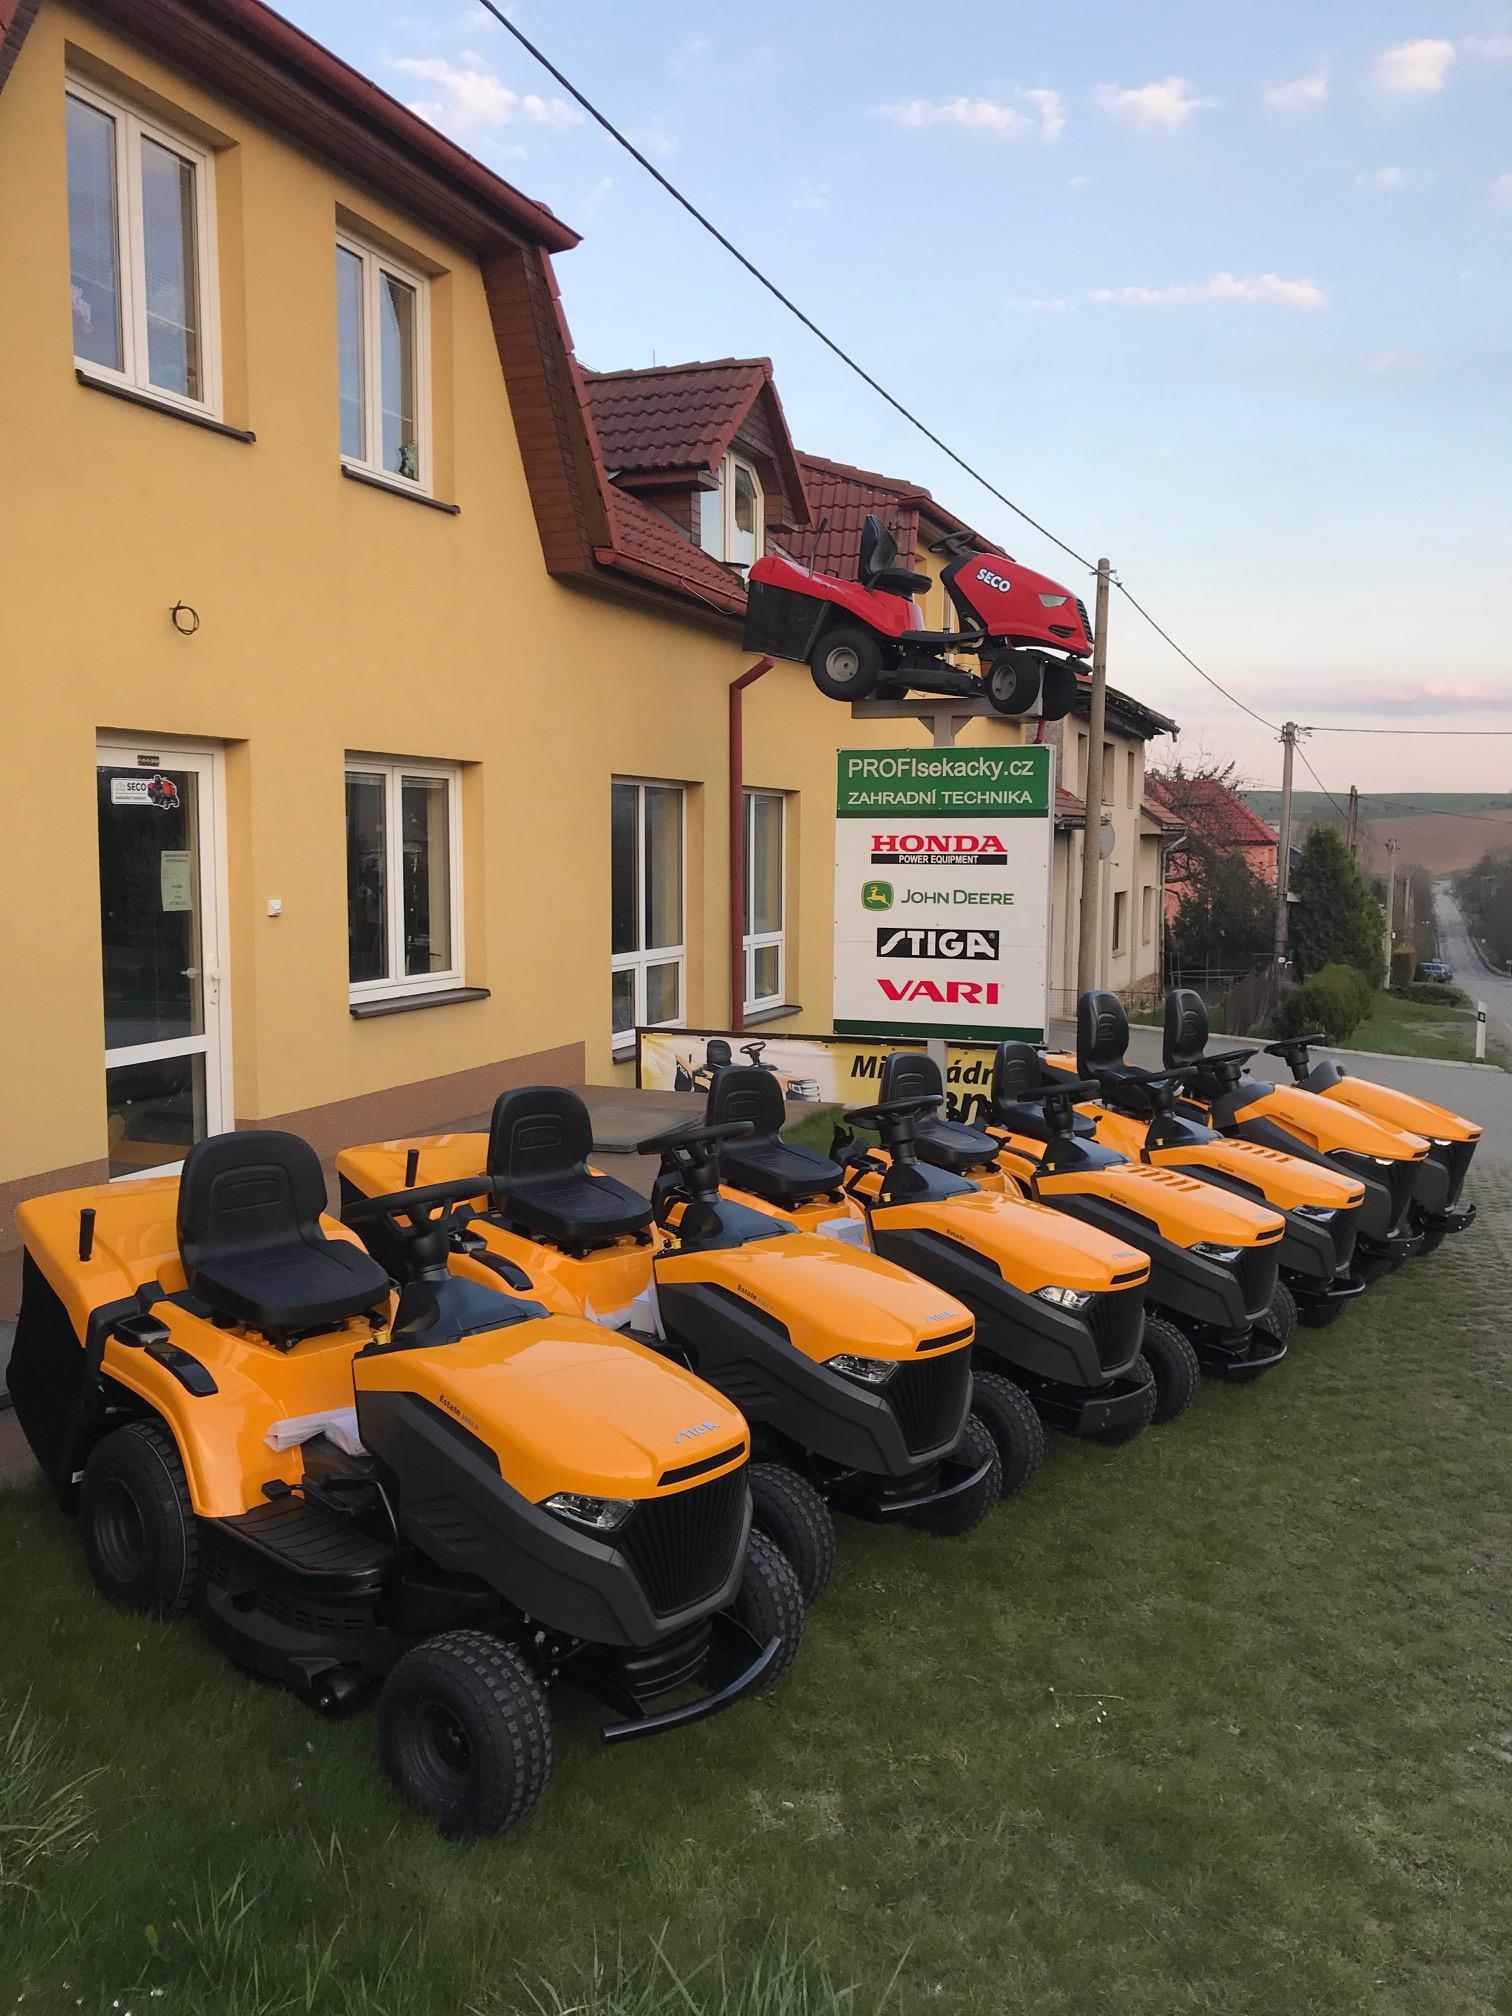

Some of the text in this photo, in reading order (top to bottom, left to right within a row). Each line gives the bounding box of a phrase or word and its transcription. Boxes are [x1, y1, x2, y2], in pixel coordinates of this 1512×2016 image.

[976, 568, 1011, 592] SECO
[848, 757, 1034, 781] PROFIsekacky.cz
[127, 782, 147, 791] SECO
[847, 789, 1033, 805] ZAHRADNÍ TECHNIKA
[871, 835, 1007, 852] HONDA
[898, 854, 979, 865] POWER EQUIPMENT
[877, 979, 999, 1005] VARI
[737, 1283, 757, 1300] Estate
[439, 1394, 461, 1416] Estate
